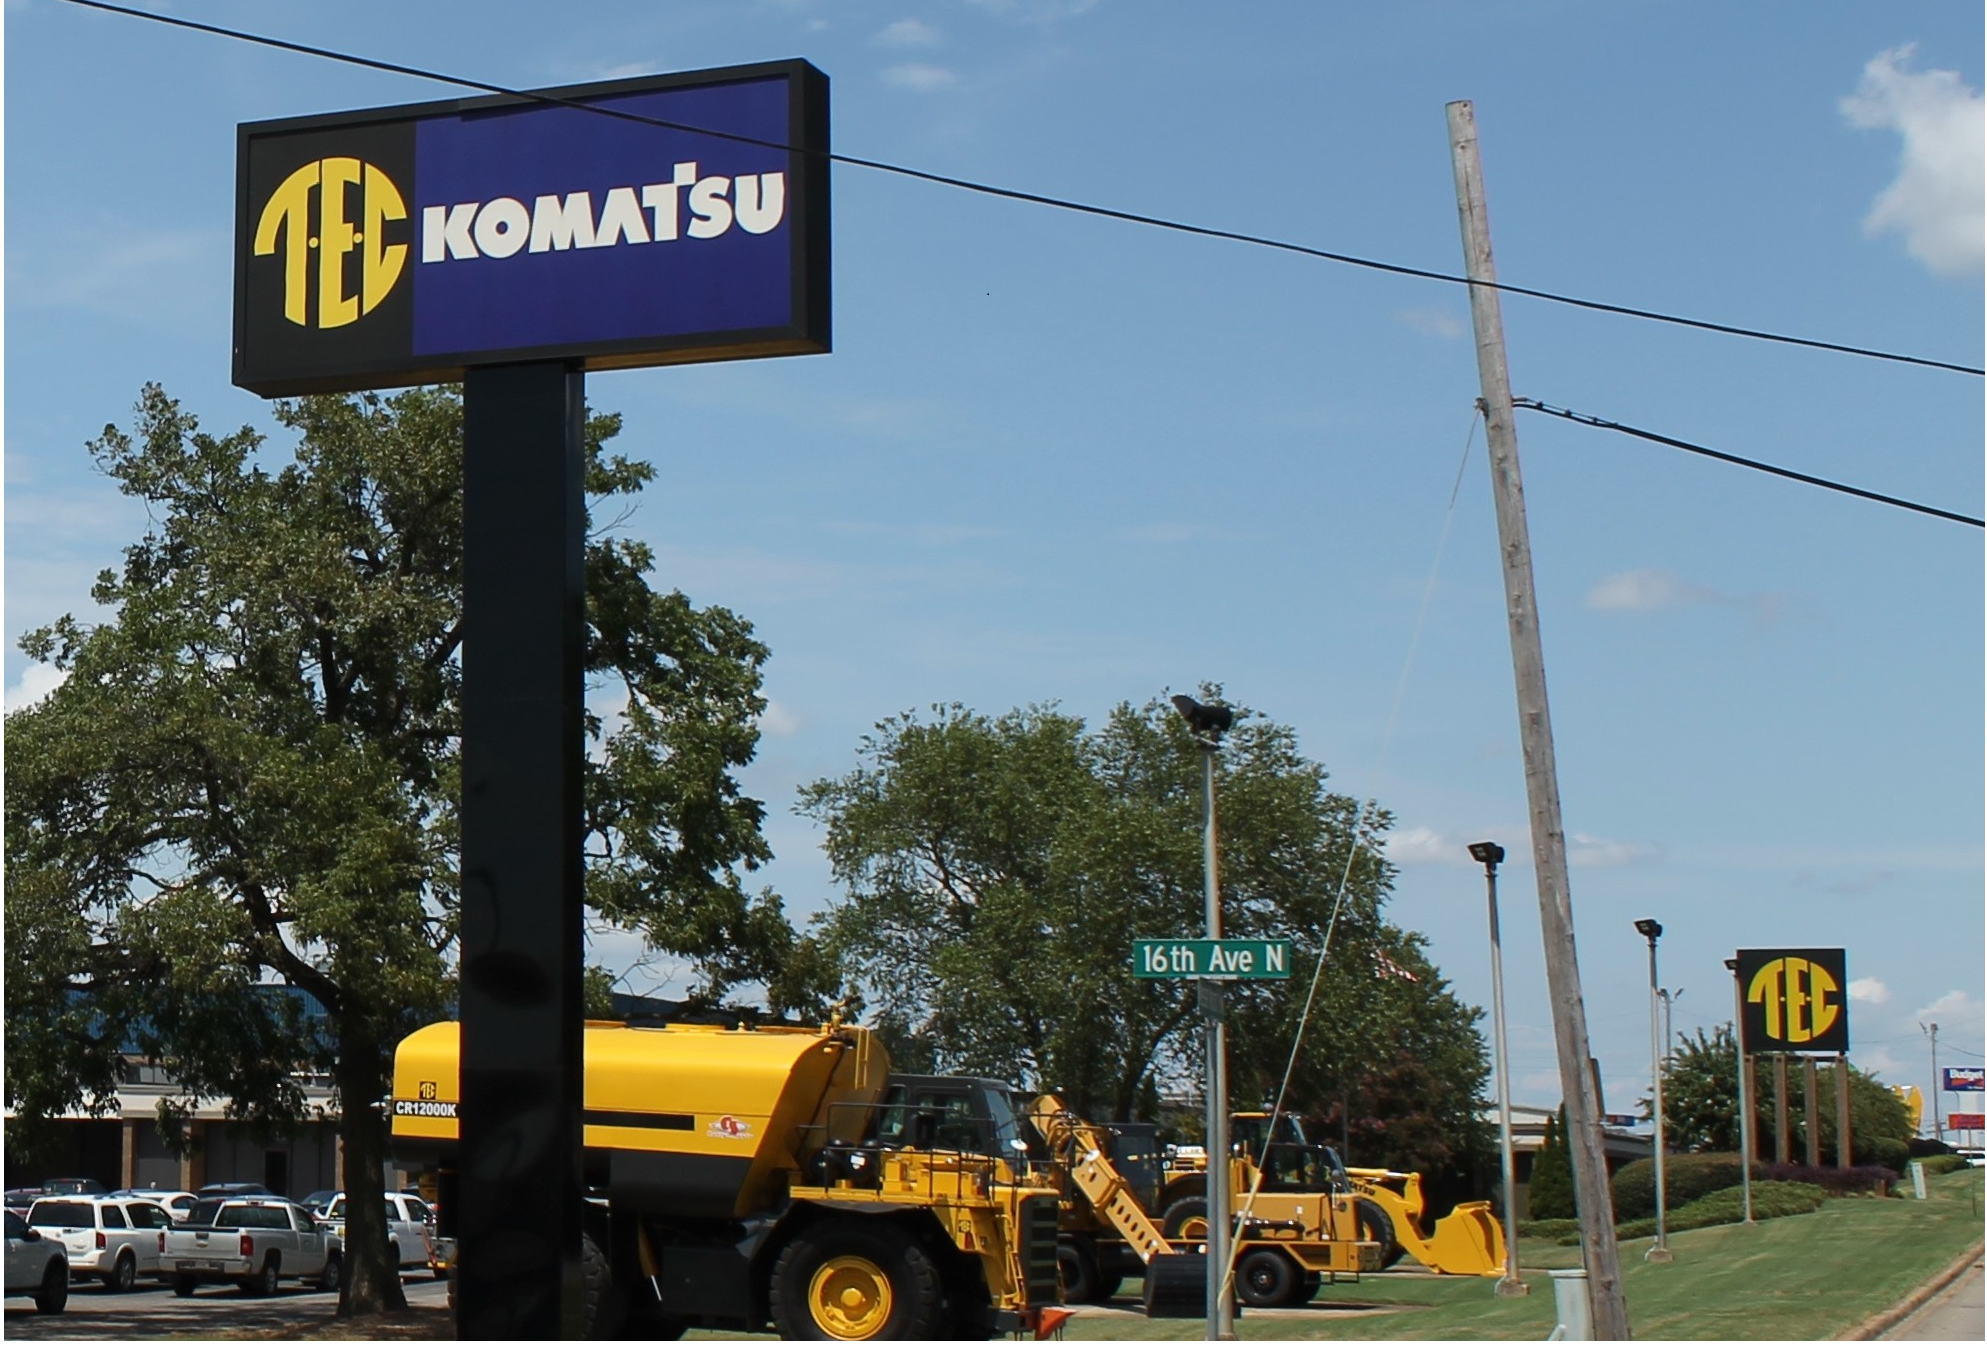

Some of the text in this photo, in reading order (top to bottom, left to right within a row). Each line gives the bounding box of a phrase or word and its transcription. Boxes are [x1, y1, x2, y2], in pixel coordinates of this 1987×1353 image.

[422, 161, 784, 264] KOMATSU
[1142, 944, 1283, 973] 16th Ave N
[1949, 1069, 1985, 1082] Budget
[396, 1101, 457, 1117] CR12000K
